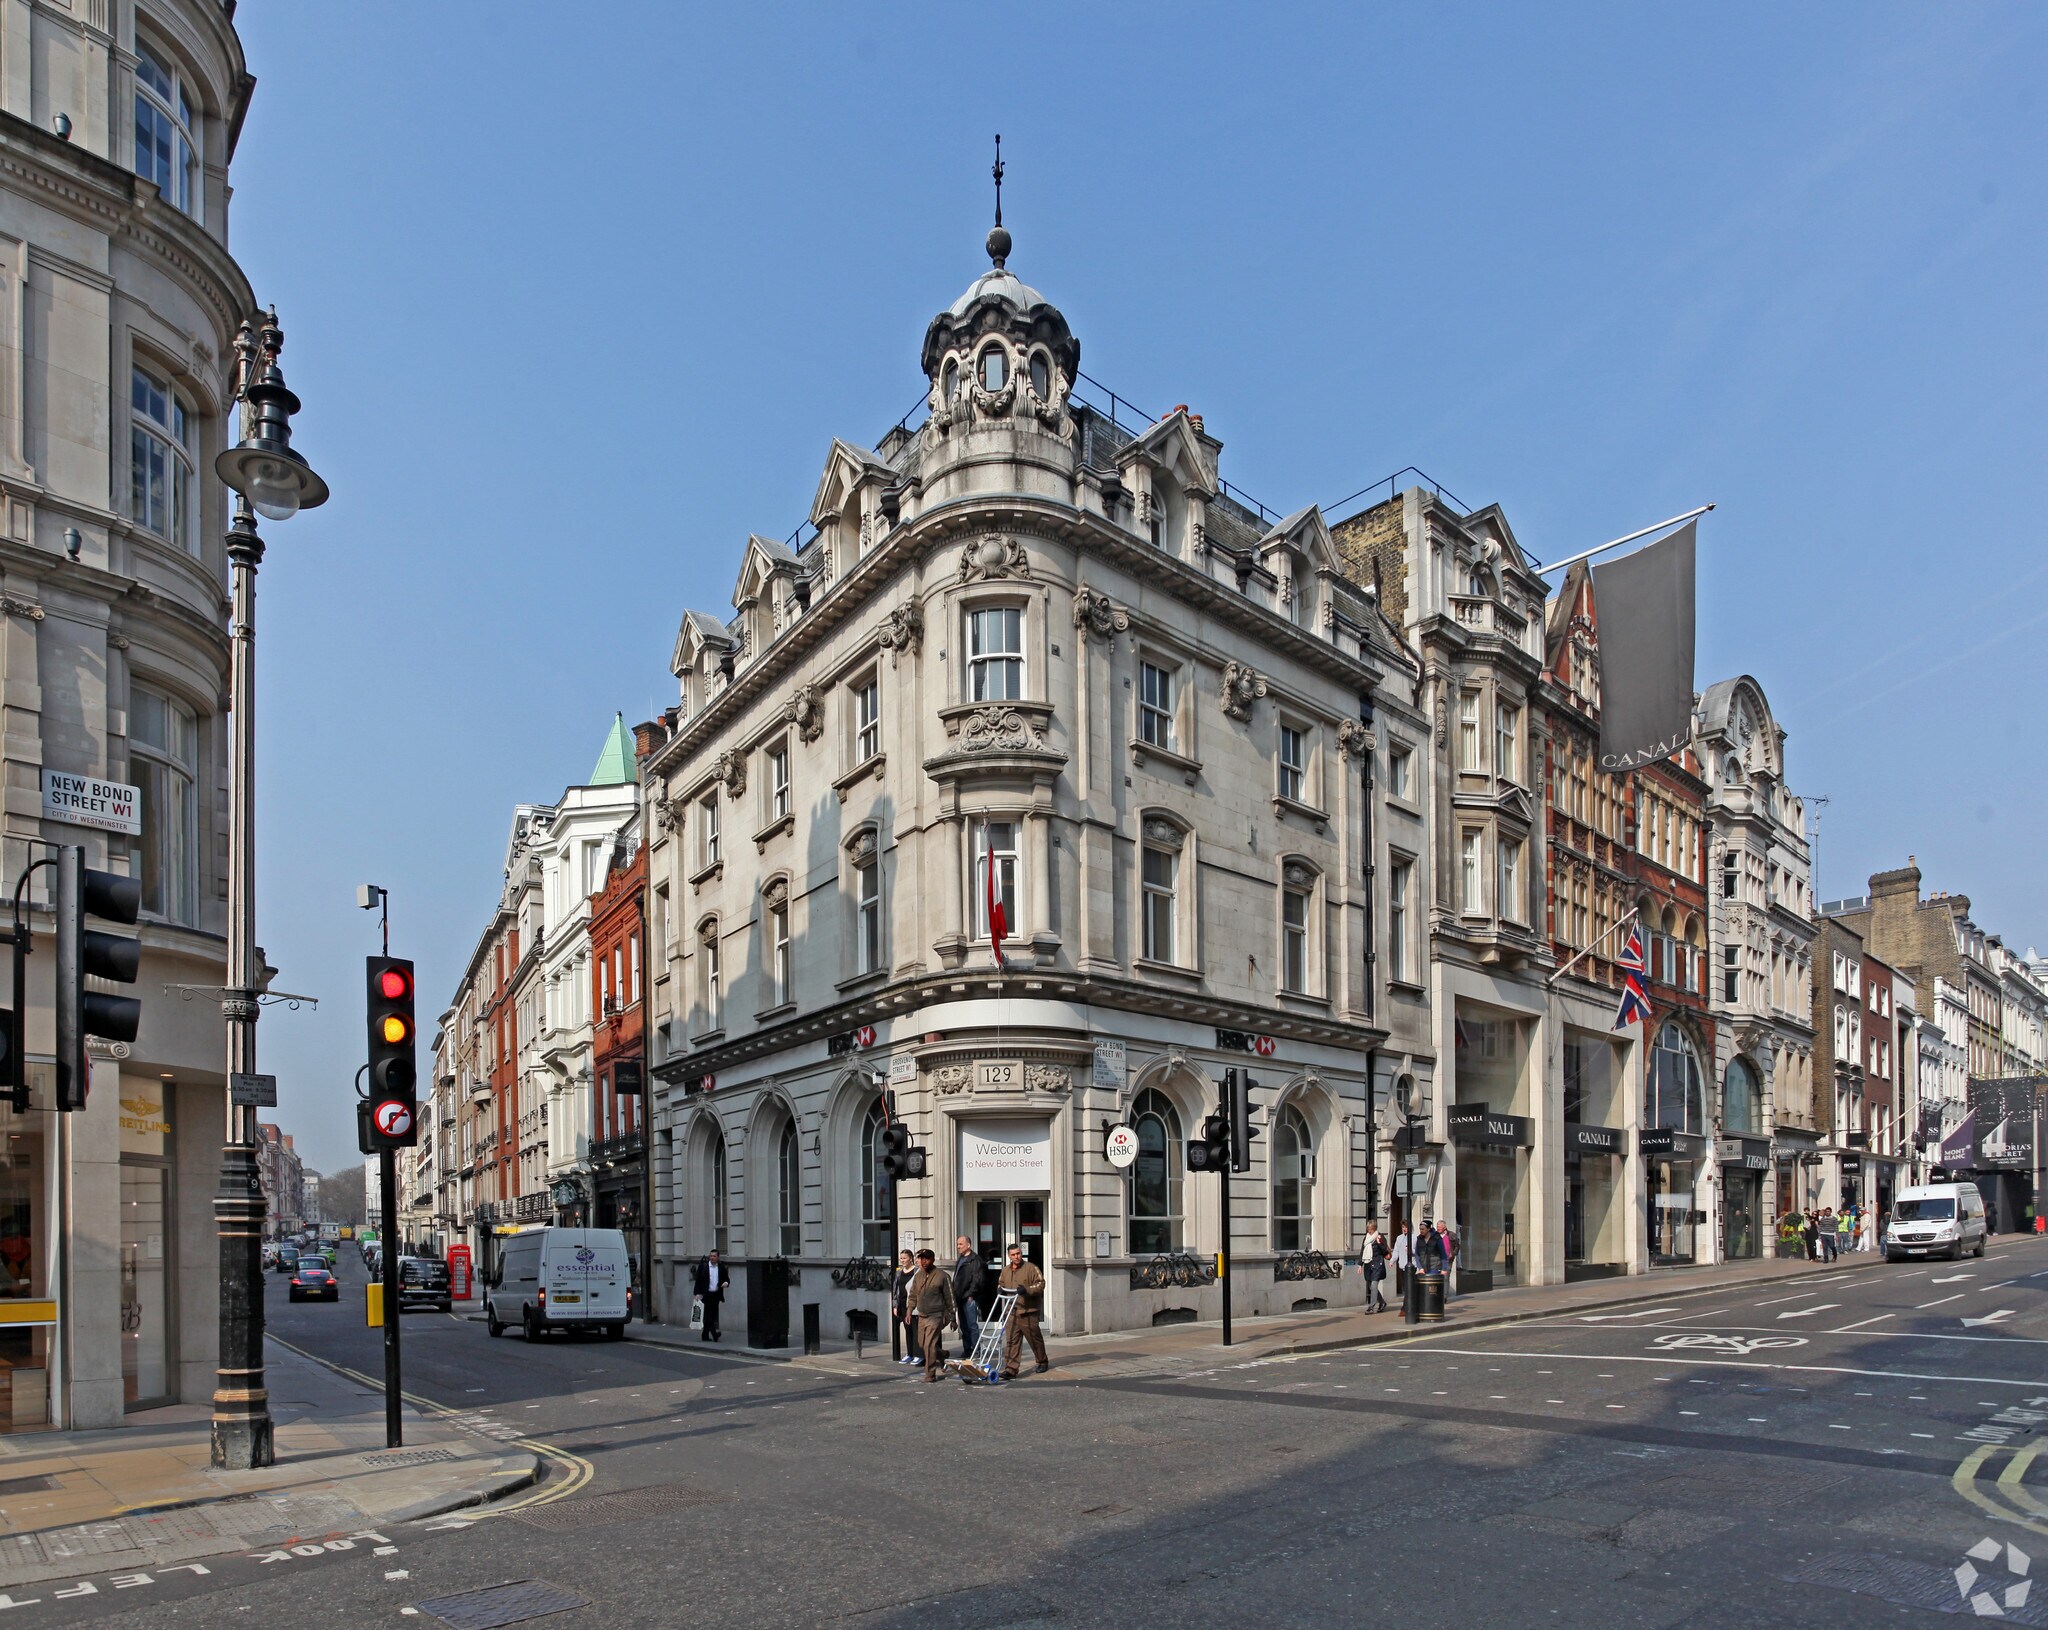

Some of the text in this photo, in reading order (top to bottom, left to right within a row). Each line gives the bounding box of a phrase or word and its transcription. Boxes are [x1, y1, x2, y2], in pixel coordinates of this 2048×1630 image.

[1601, 726, 1689, 768] CANALI
[51, 775, 132, 802] NEW BOND
[52, 791, 131, 818] STREET W1
[51, 810, 67, 819] CITY
[80, 816, 128, 830] WESTMINSTER
[1109, 1041, 1123, 1051] BOND
[1096, 1049, 1123, 1059] STREET W1
[985, 1067, 1011, 1083] 129
[119, 1116, 172, 1134] REITLING
[1449, 1115, 1482, 1124] CANALI
[1488, 1121, 1514, 1136] NALI
[1578, 1131, 1611, 1146] CANALI
[976, 1143, 1033, 1155] Welcome
[1109, 1144, 1134, 1157] HSBC
[1944, 1148, 1966, 1156] MONT
[2005, 1143, 2032, 1151] ORIA'S
[975, 1160, 994, 1168] New
[996, 1159, 1018, 1168] Bond
[1019, 1159, 1044, 1168] Street
[251, 1178, 258, 1188] 9
[557, 1264, 616, 1272] essential
[247, 1529, 393, 1564] LOOK
